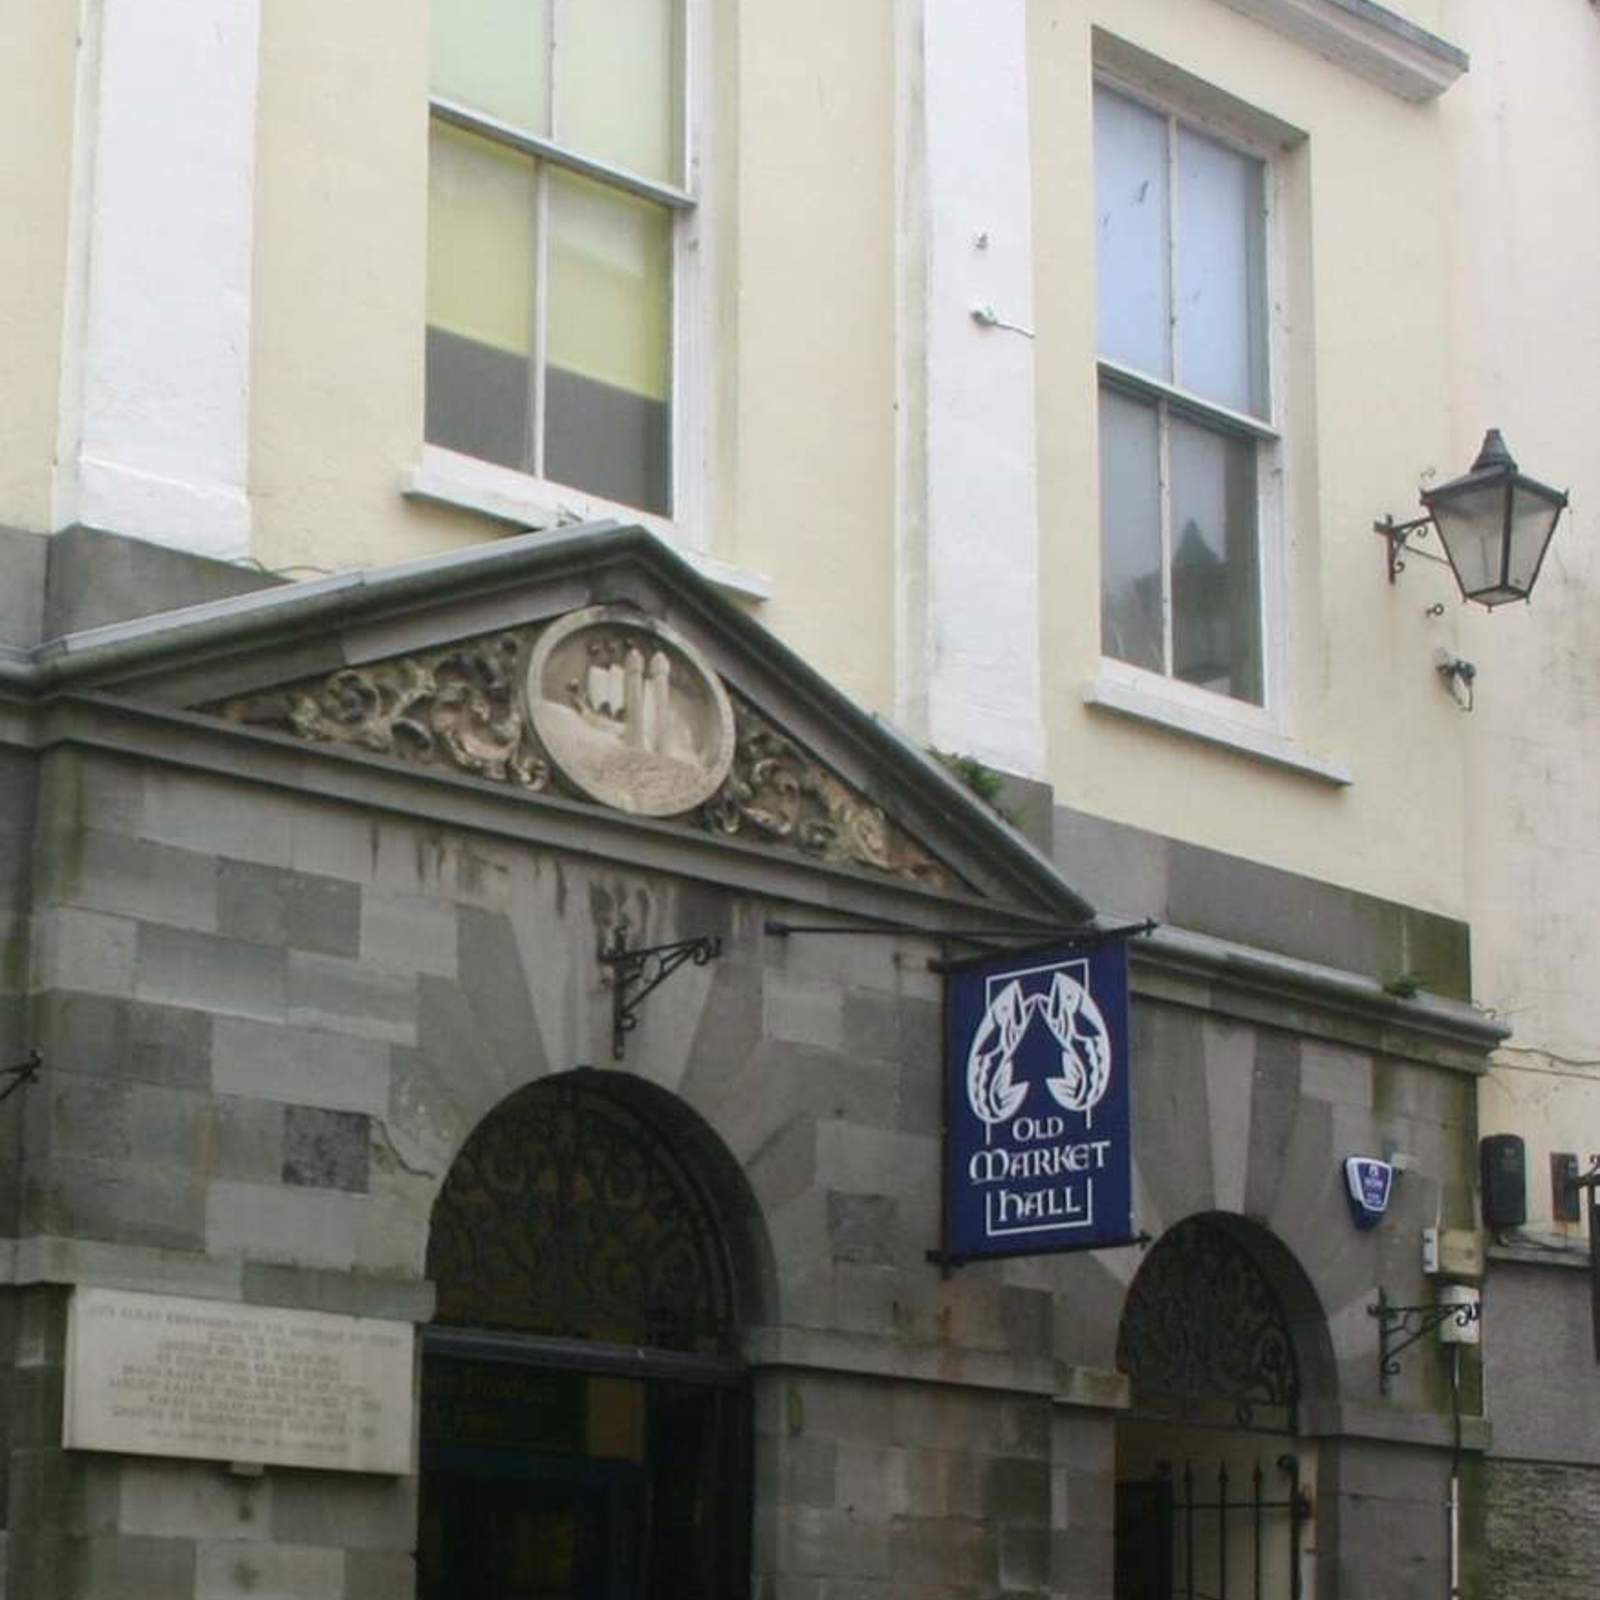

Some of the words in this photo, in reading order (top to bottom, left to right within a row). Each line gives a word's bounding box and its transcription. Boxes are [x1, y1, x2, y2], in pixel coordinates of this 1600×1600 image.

[1012, 1117, 1064, 1142] OLD
[970, 1141, 1110, 1183] MARKET
[998, 1185, 1082, 1222] HALL
